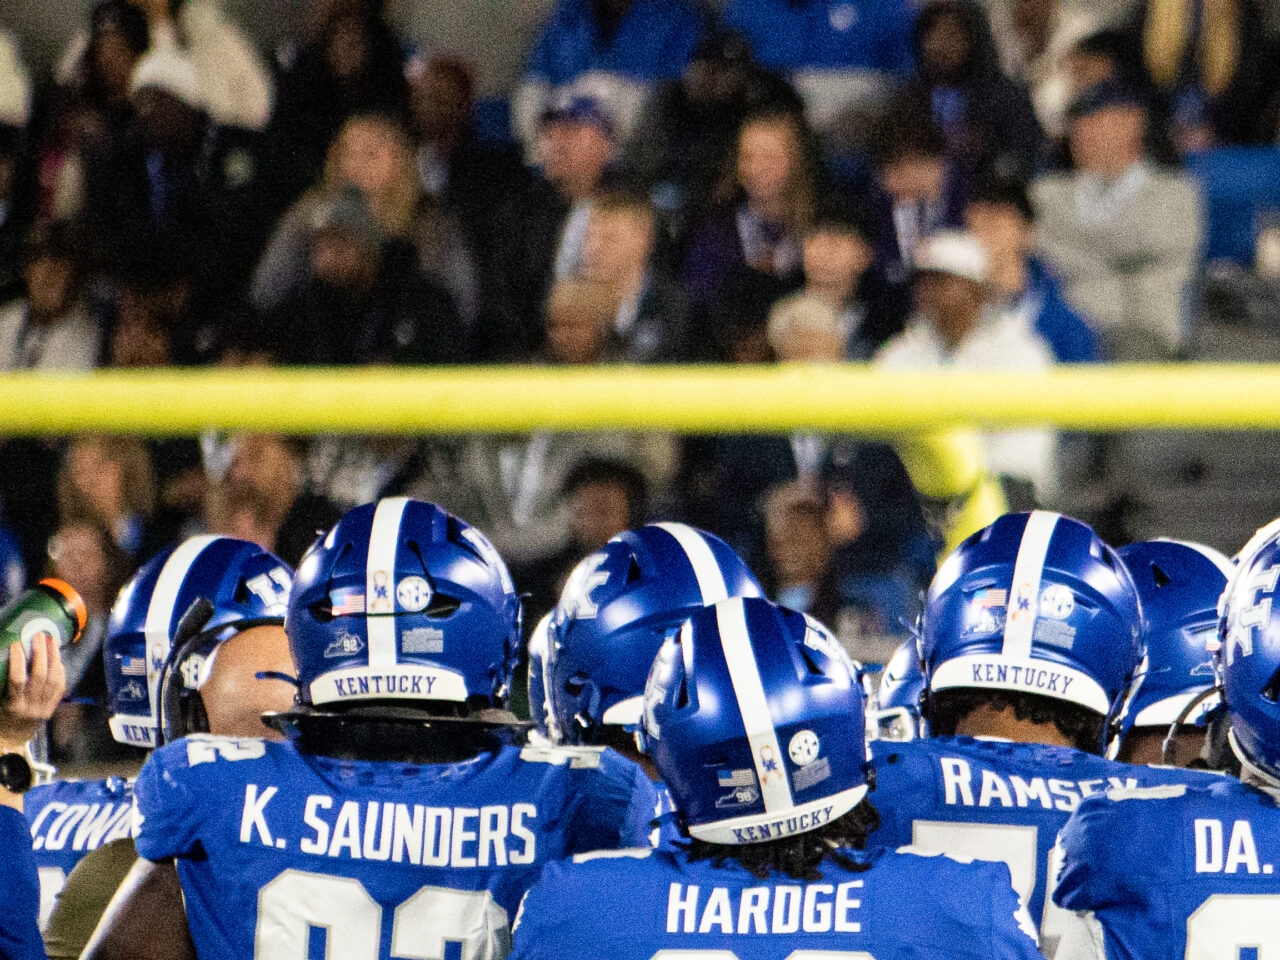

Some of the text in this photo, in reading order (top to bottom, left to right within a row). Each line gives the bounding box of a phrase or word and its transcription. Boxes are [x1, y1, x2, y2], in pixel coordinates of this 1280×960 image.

[334, 675, 437, 697] KENTUCKY
[972, 663, 1074, 694] KENTUCKY
[239, 784, 537, 868] K. SAUNDERS
[732, 805, 834, 843] KENTUCKY
[1193, 818, 1274, 875] DA.
[665, 879, 865, 935] HARDGE
